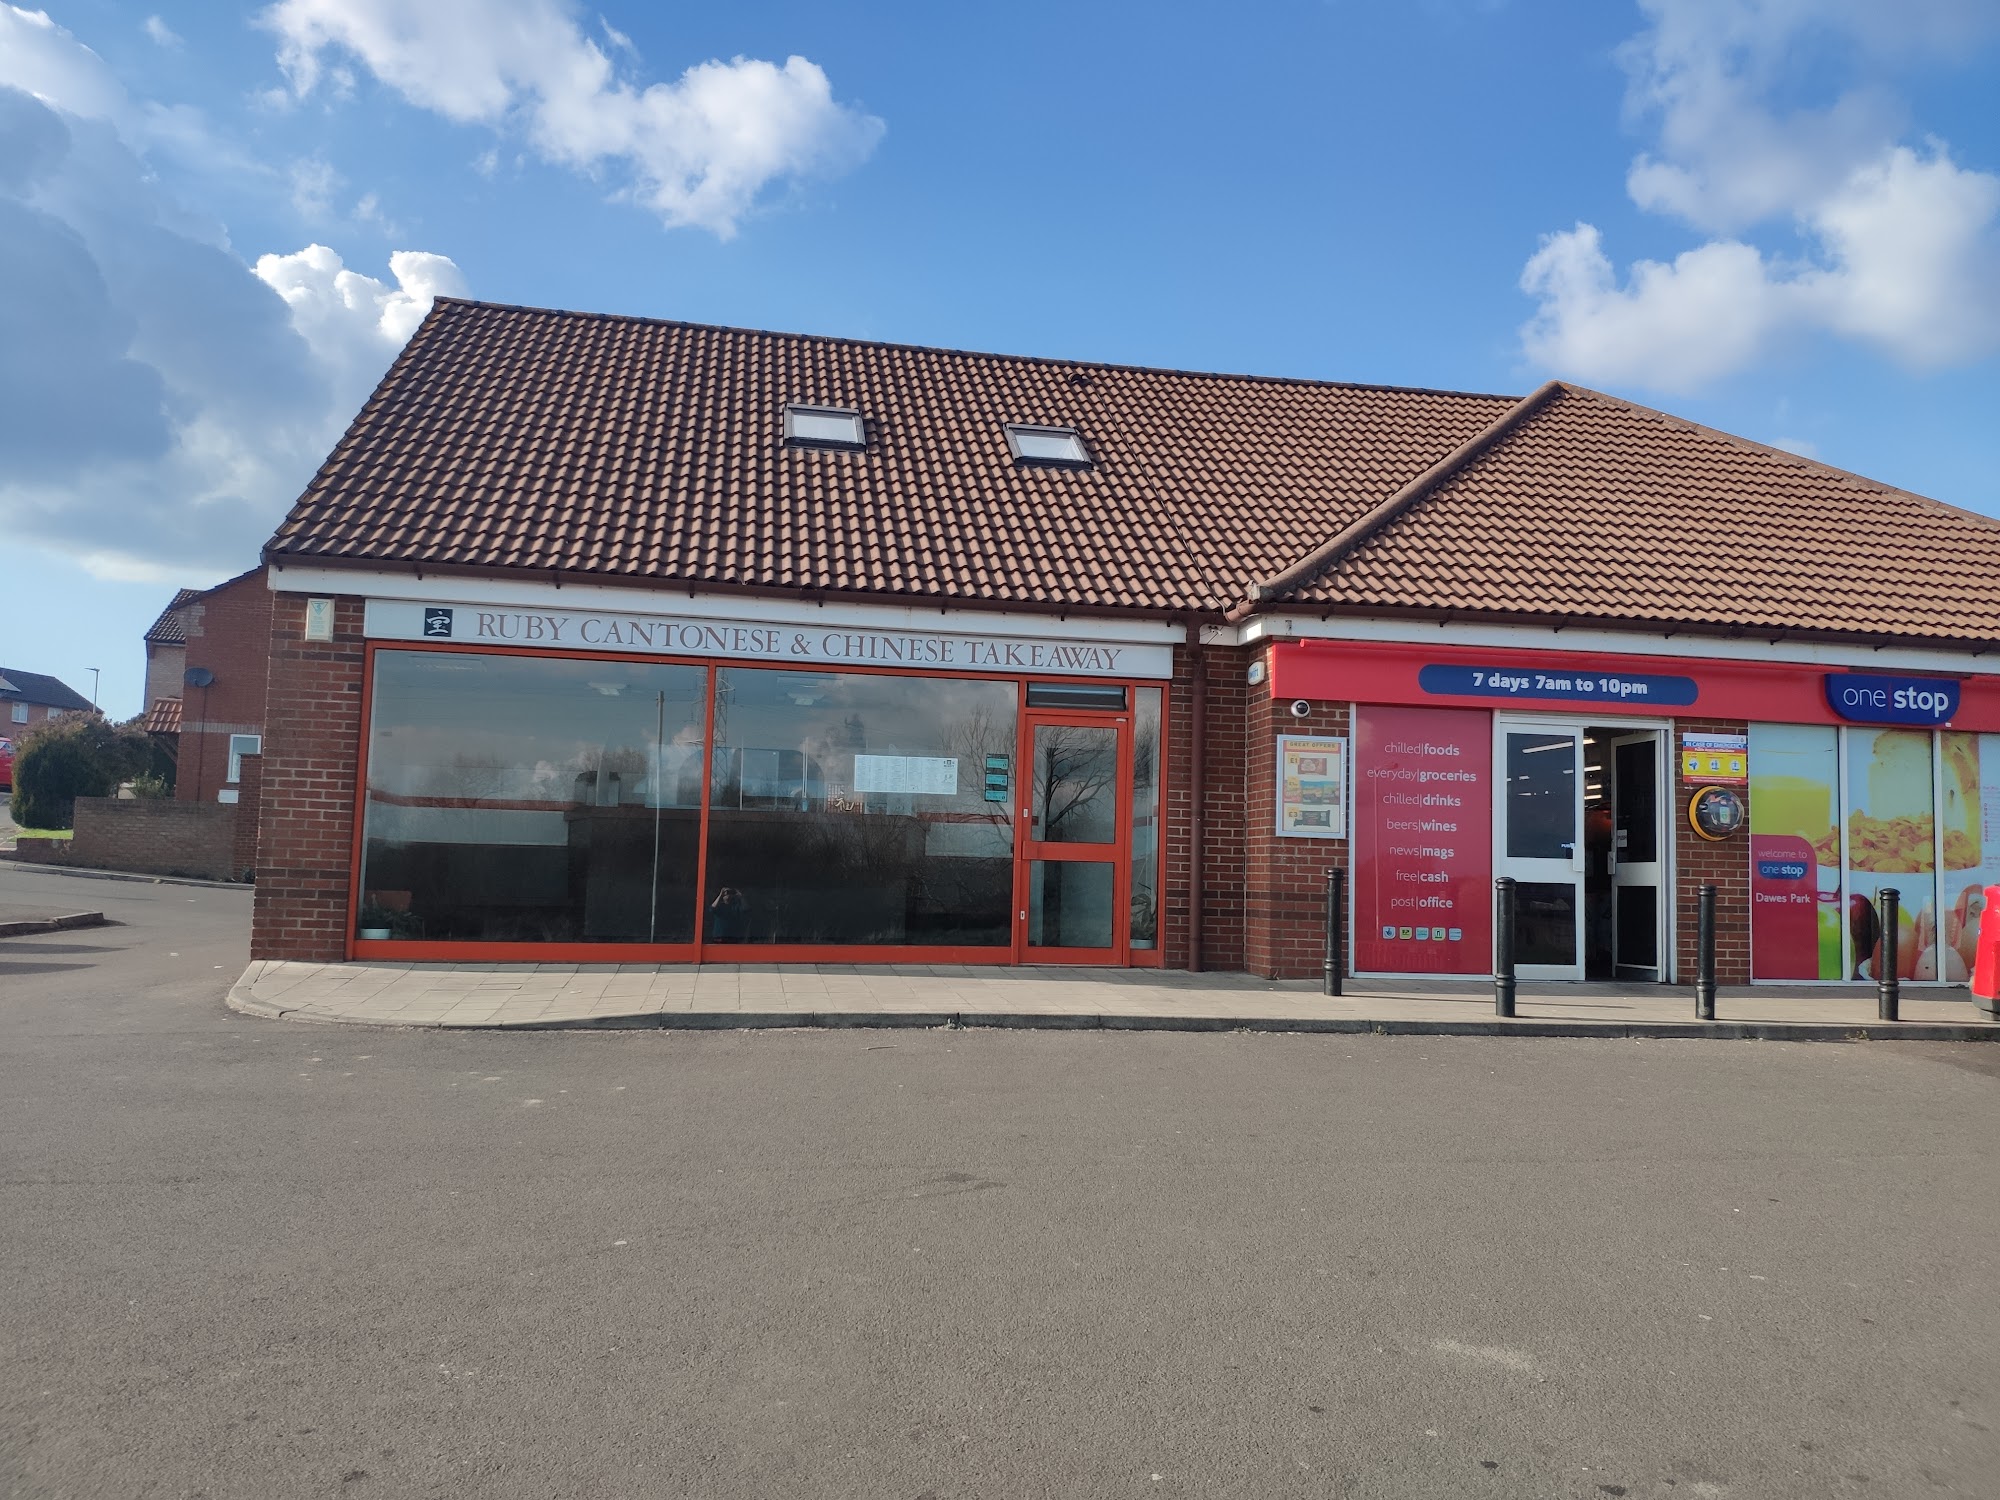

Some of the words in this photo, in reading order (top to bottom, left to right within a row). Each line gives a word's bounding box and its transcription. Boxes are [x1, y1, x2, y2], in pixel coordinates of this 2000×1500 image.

[477, 612, 568, 641] RUBY
[580, 619, 781, 653] CANTONESE
[790, 633, 811, 655] &
[822, 633, 954, 663] CHINESE
[963, 640, 1122, 670] TAKEAWAY
[1472, 672, 1484, 687] 7
[1488, 673, 1530, 693] days
[1535, 675, 1572, 691] 7am
[1575, 678, 1594, 692] to
[1599, 678, 1648, 698] 10pm
[1843, 688, 1887, 708] one
[1893, 685, 1949, 718] stop
[1384, 742, 1421, 754] chilled
[1424, 743, 1460, 756] foods
[1367, 768, 1418, 781] everyday
[1419, 769, 1477, 782] groceries
[1382, 793, 1420, 805] chilled
[1422, 794, 1461, 807] drinks
[1386, 818, 1418, 831] beers
[1420, 818, 1457, 832] wines
[1389, 846, 1419, 856] news
[1422, 847, 1454, 860] mags
[1758, 849, 1796, 859] welcome
[1798, 850, 1808, 859] to
[1396, 869, 1417, 881] free
[1420, 871, 1449, 883] cash
[1761, 866, 1779, 874] one
[1781, 864, 1804, 877] stop
[1391, 897, 1415, 909] post
[1418, 896, 1453, 909] office
[1755, 892, 1787, 903] Dawes
[1790, 893, 1811, 903] Park
